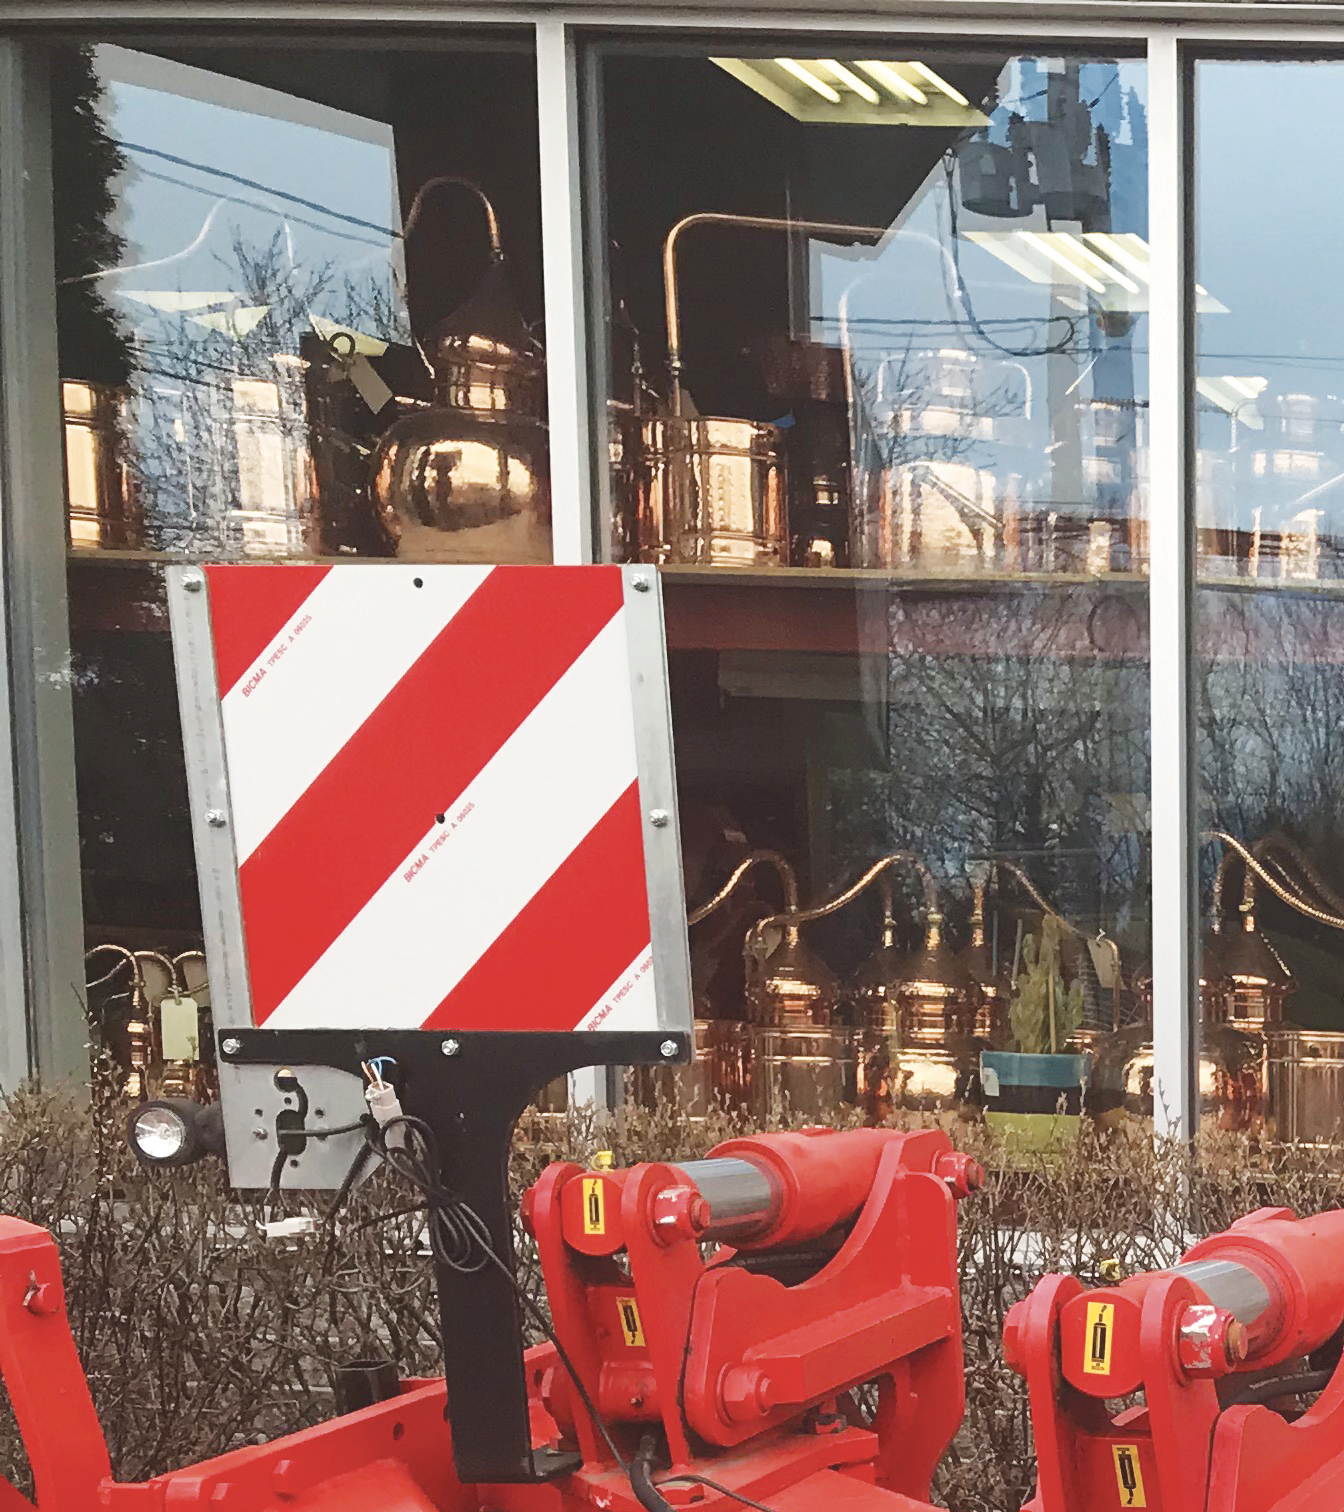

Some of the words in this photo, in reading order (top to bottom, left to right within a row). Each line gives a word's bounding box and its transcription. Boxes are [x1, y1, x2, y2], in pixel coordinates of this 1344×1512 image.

[242, 668, 266, 698] BICMA
[404, 854, 430, 882] BICMA
[587, 1004, 613, 1031] BICMA
